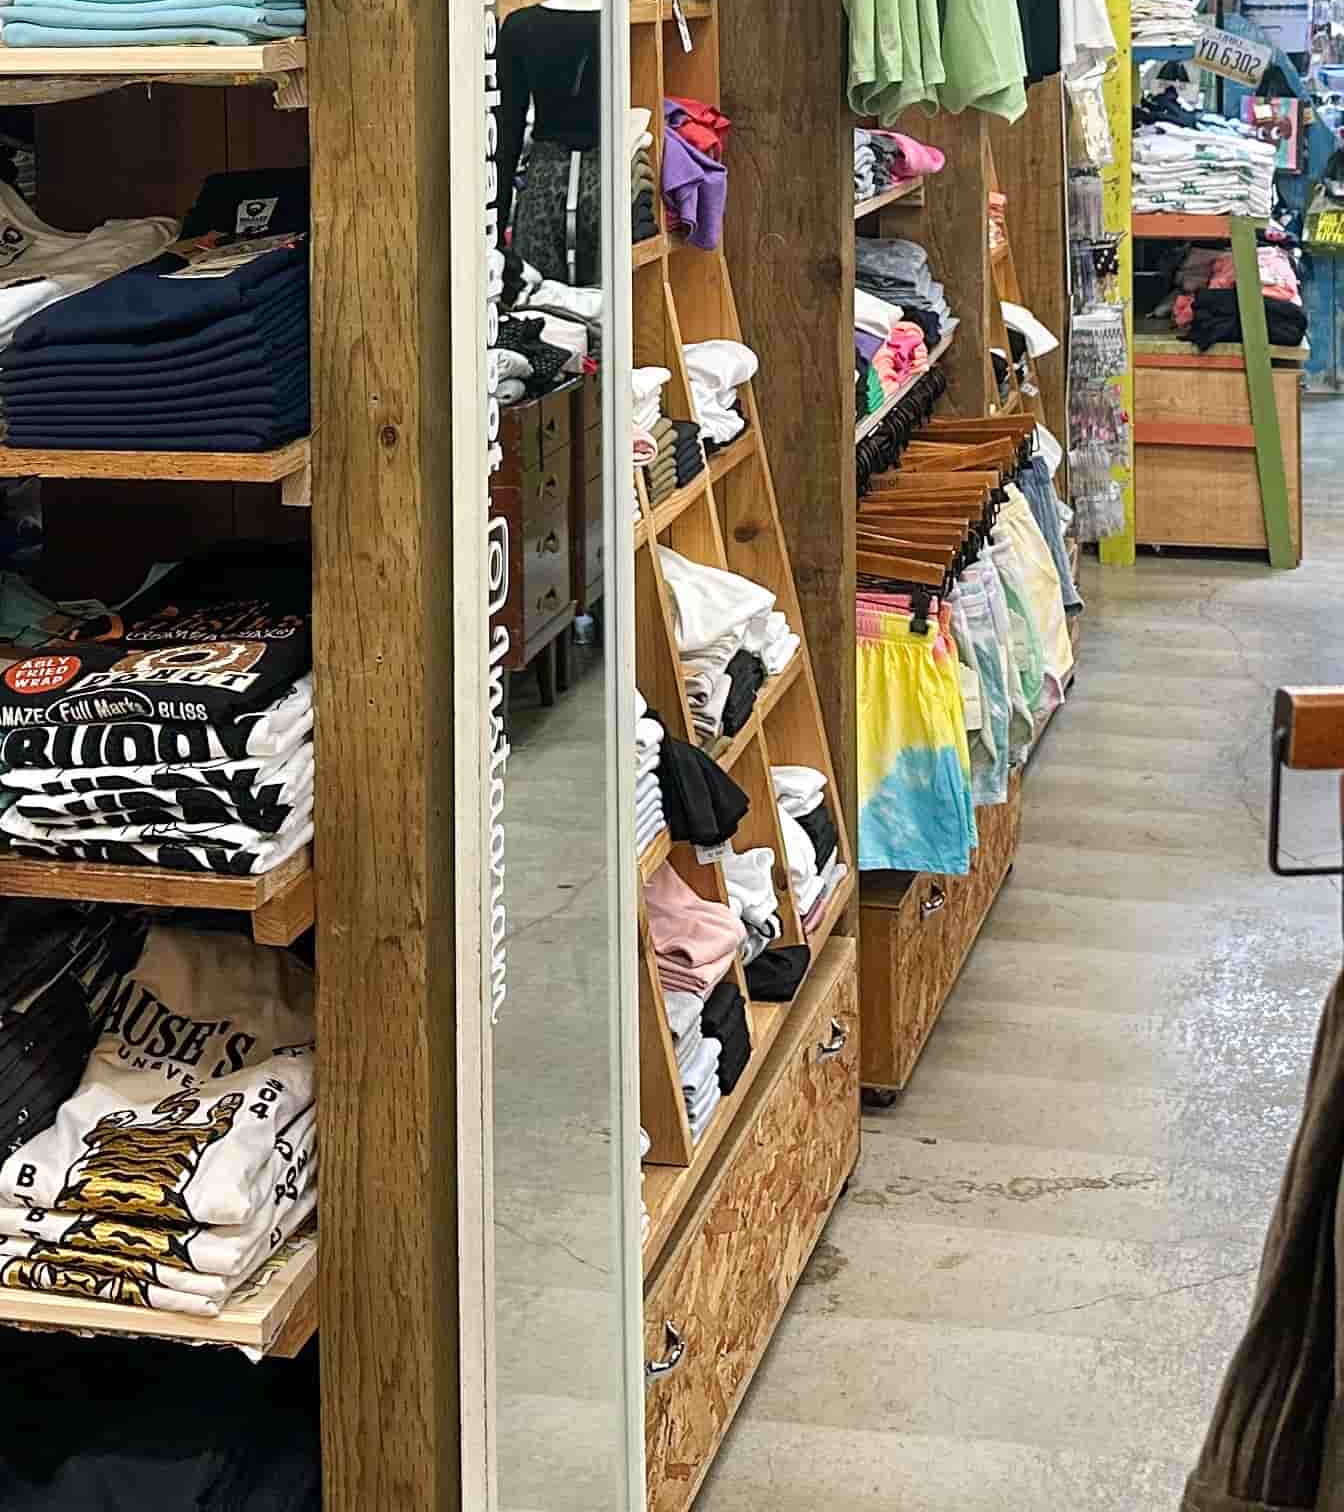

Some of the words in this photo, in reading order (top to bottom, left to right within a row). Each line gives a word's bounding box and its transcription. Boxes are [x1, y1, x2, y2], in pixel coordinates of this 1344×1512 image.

[1220, 47, 1262, 76] 6302
[14, 664, 69, 679] FRIED
[14, 675, 64, 689] WRAP
[59, 701, 90, 723] Full
[158, 701, 208, 722] BLISS
